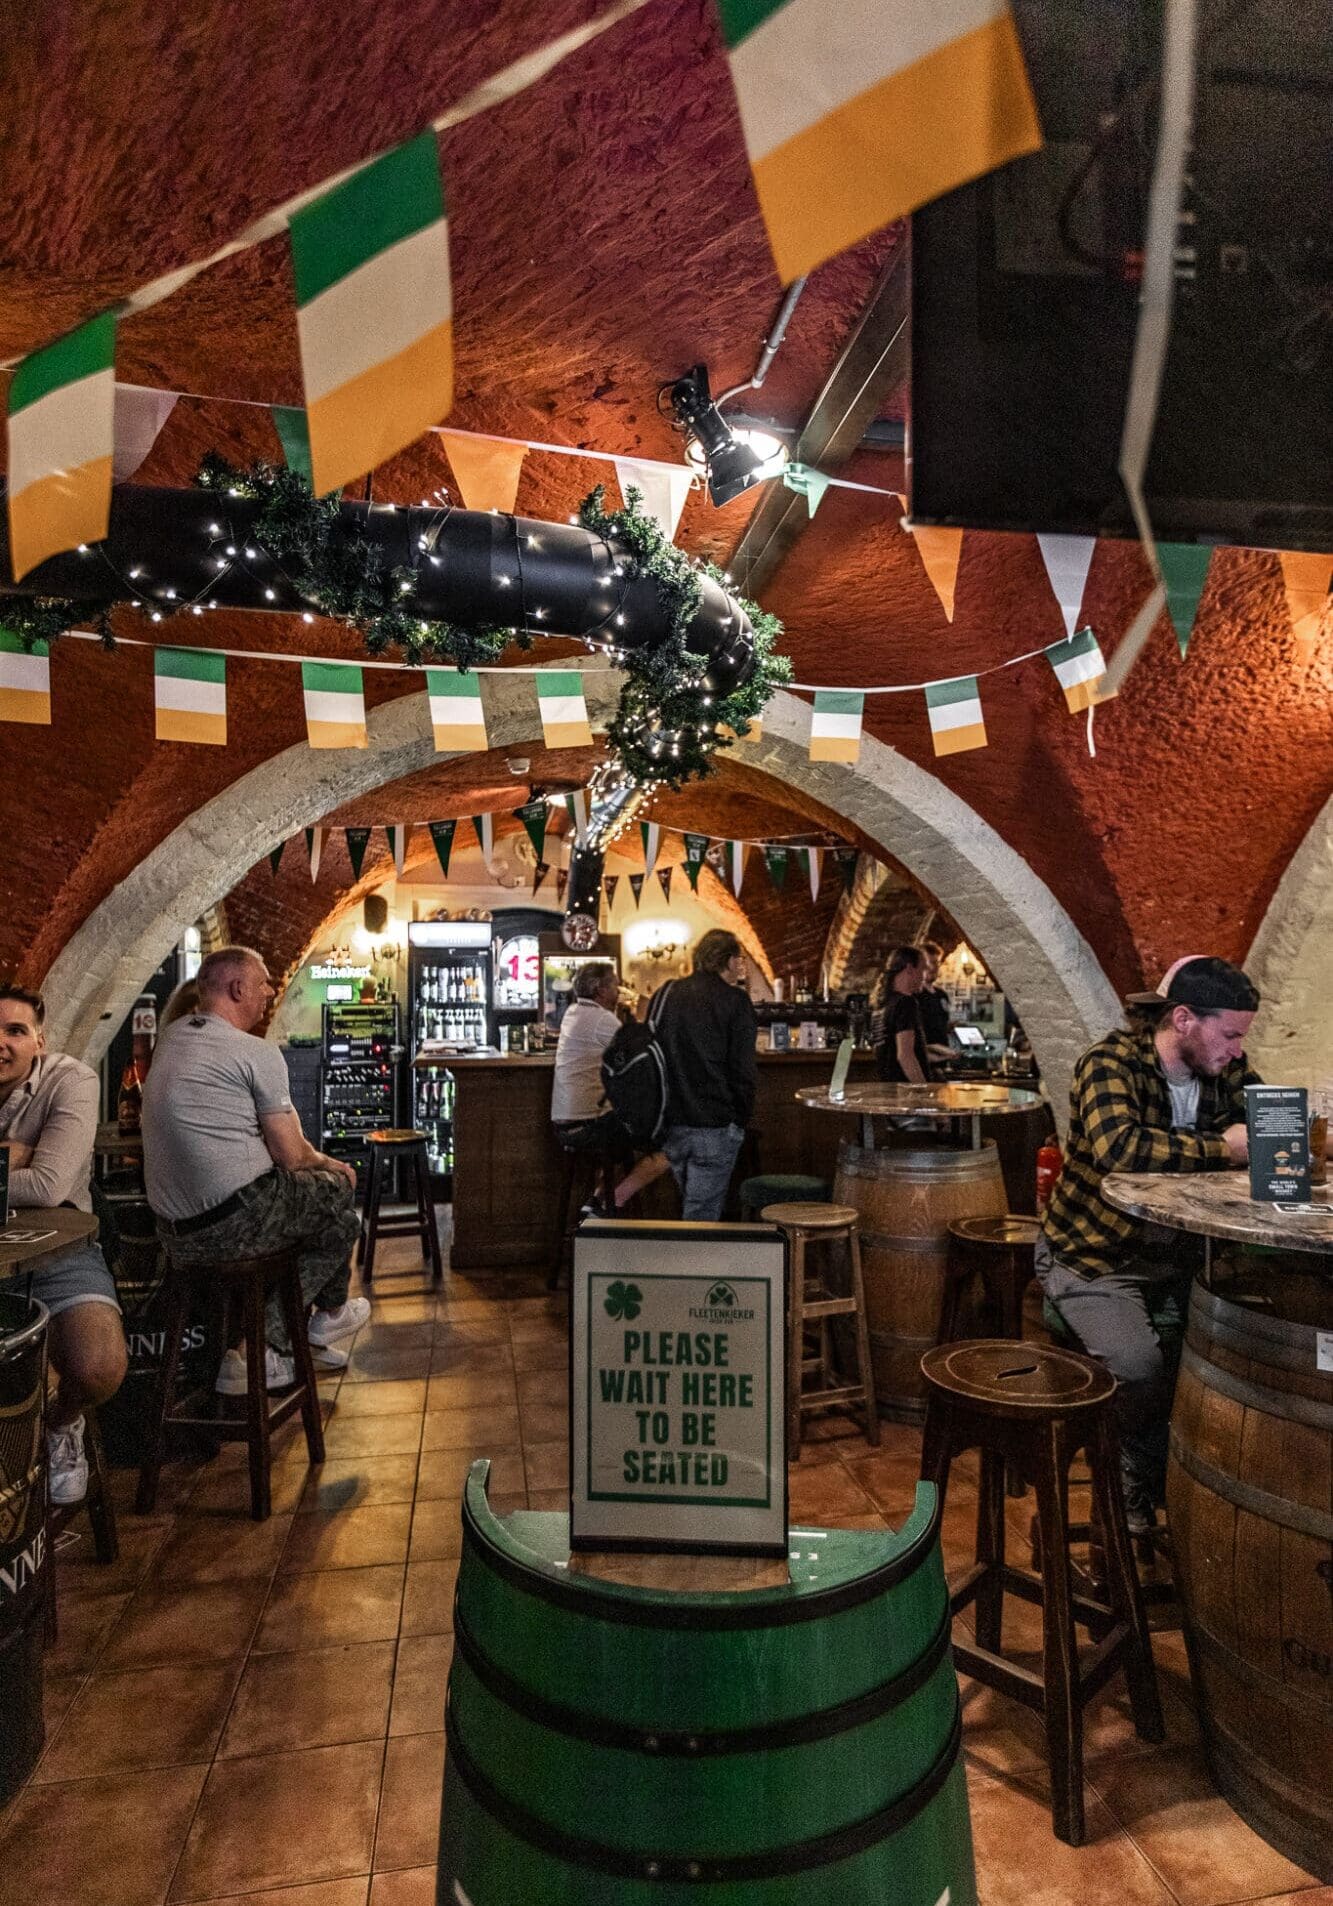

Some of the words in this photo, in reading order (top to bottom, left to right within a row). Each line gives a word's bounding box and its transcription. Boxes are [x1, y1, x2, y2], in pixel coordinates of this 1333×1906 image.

[311, 965, 371, 979] Heineken
[508, 955, 540, 981] 13
[134, 1014, 154, 1029] 13
[624, 1330, 729, 1367] PLEASE
[600, 1369, 670, 1405] WAIT
[682, 1372, 754, 1408] HERE
[636, 1410, 669, 1445] TO
[682, 1412, 716, 1446] BE
[623, 1450, 729, 1486] SEATED
